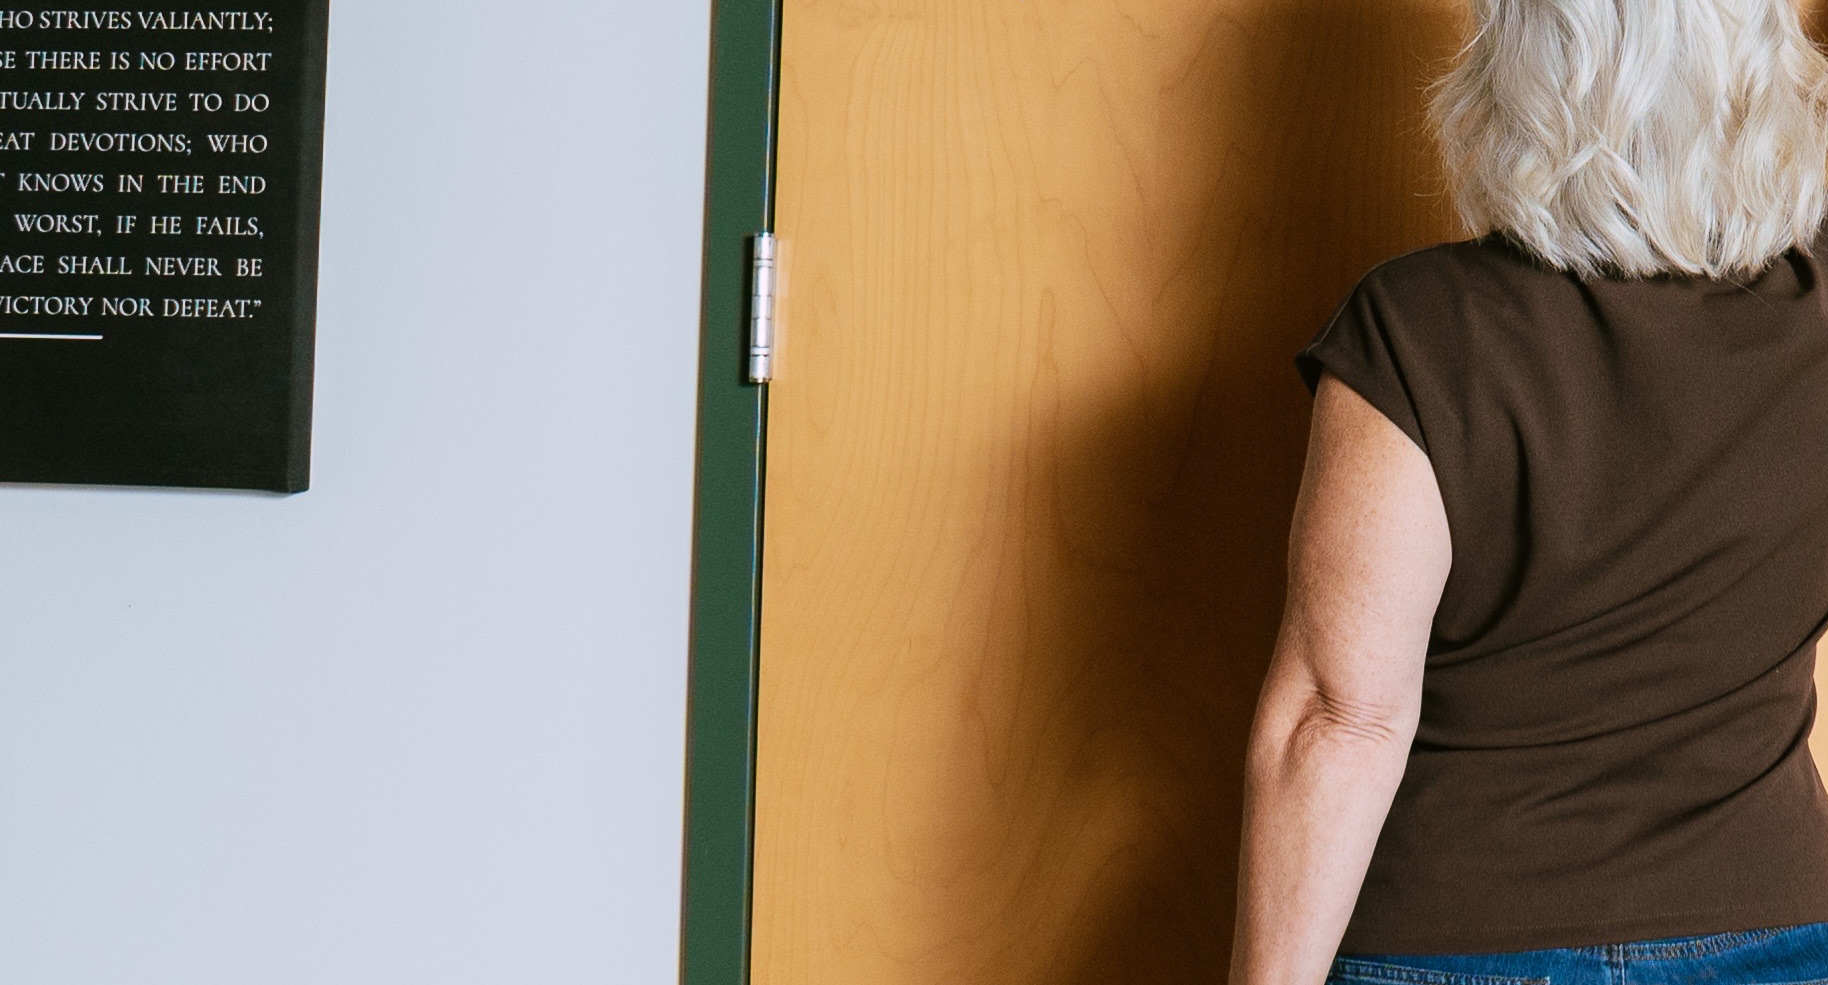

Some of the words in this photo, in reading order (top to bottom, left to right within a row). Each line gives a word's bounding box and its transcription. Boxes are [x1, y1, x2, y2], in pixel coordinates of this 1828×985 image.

[39, 10, 132, 30] STRIVES
[137, 10, 273, 33] VALIANTLY;
[25, 50, 101, 70] THERE
[110, 51, 130, 71] IS
[139, 51, 176, 71] NO
[185, 51, 273, 73] EFFORT
[0, 91, 86, 111] TUALLY
[96, 91, 177, 112] STRIVE
[188, 92, 223, 112] TO
[234, 93, 270, 113] DO
[50, 132, 192, 155] DEVOTIONS;
[207, 134, 268, 154] WHO
[17, 172, 104, 193] KNOWS
[118, 174, 144, 194] IN
[157, 174, 204, 194] THE
[218, 175, 266, 195] END
[14, 213, 102, 237] WORST,
[116, 214, 137, 235] IF
[150, 215, 182, 235] HE
[196, 216, 264, 239] FAILS,
[57, 255, 133, 276] SHALL
[145, 256, 222, 277] NEVER
[236, 258, 263, 277] BE
[101, 297, 154, 317] NOR
